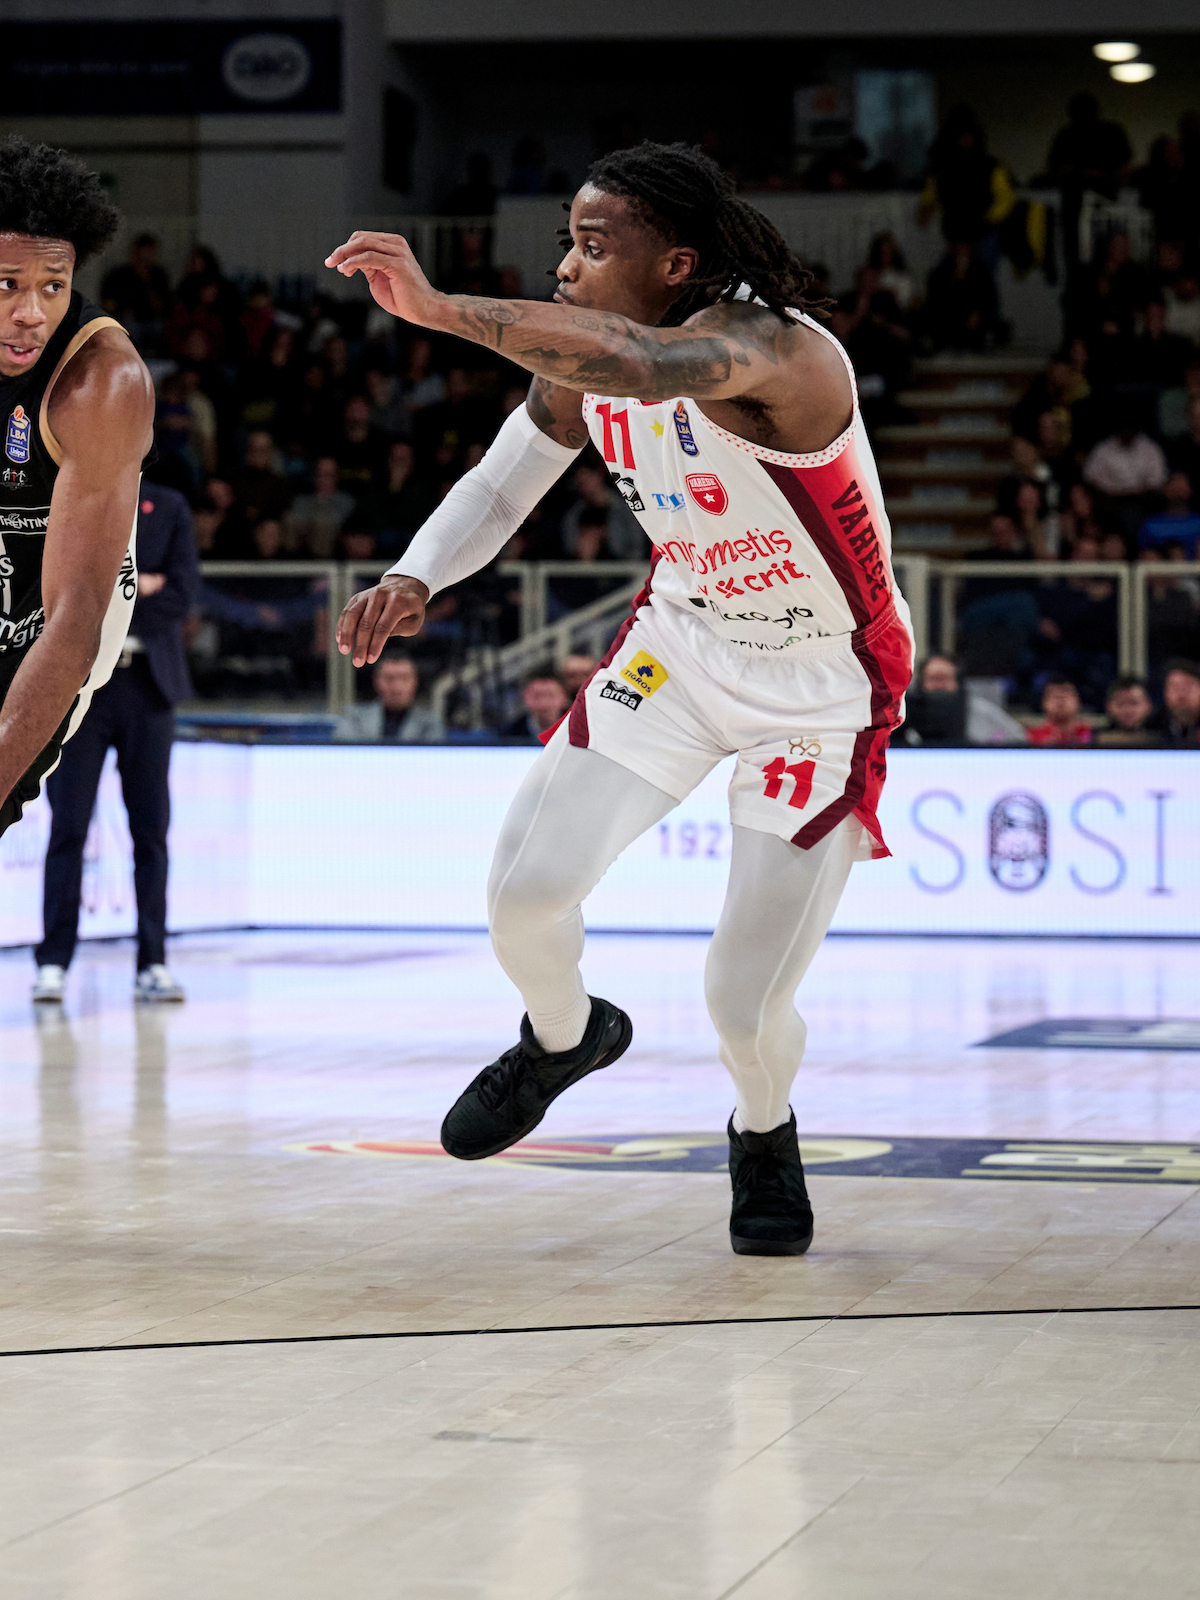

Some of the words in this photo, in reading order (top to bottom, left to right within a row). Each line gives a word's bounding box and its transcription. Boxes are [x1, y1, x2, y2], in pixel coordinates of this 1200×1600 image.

[10, 428, 27, 442] LBA
[595, 402, 637, 471] 11
[118, 549, 136, 601] TINO
[602, 687, 638, 709] errea
[624, 669, 652, 694] TIGROS
[761, 756, 817, 810] 11
